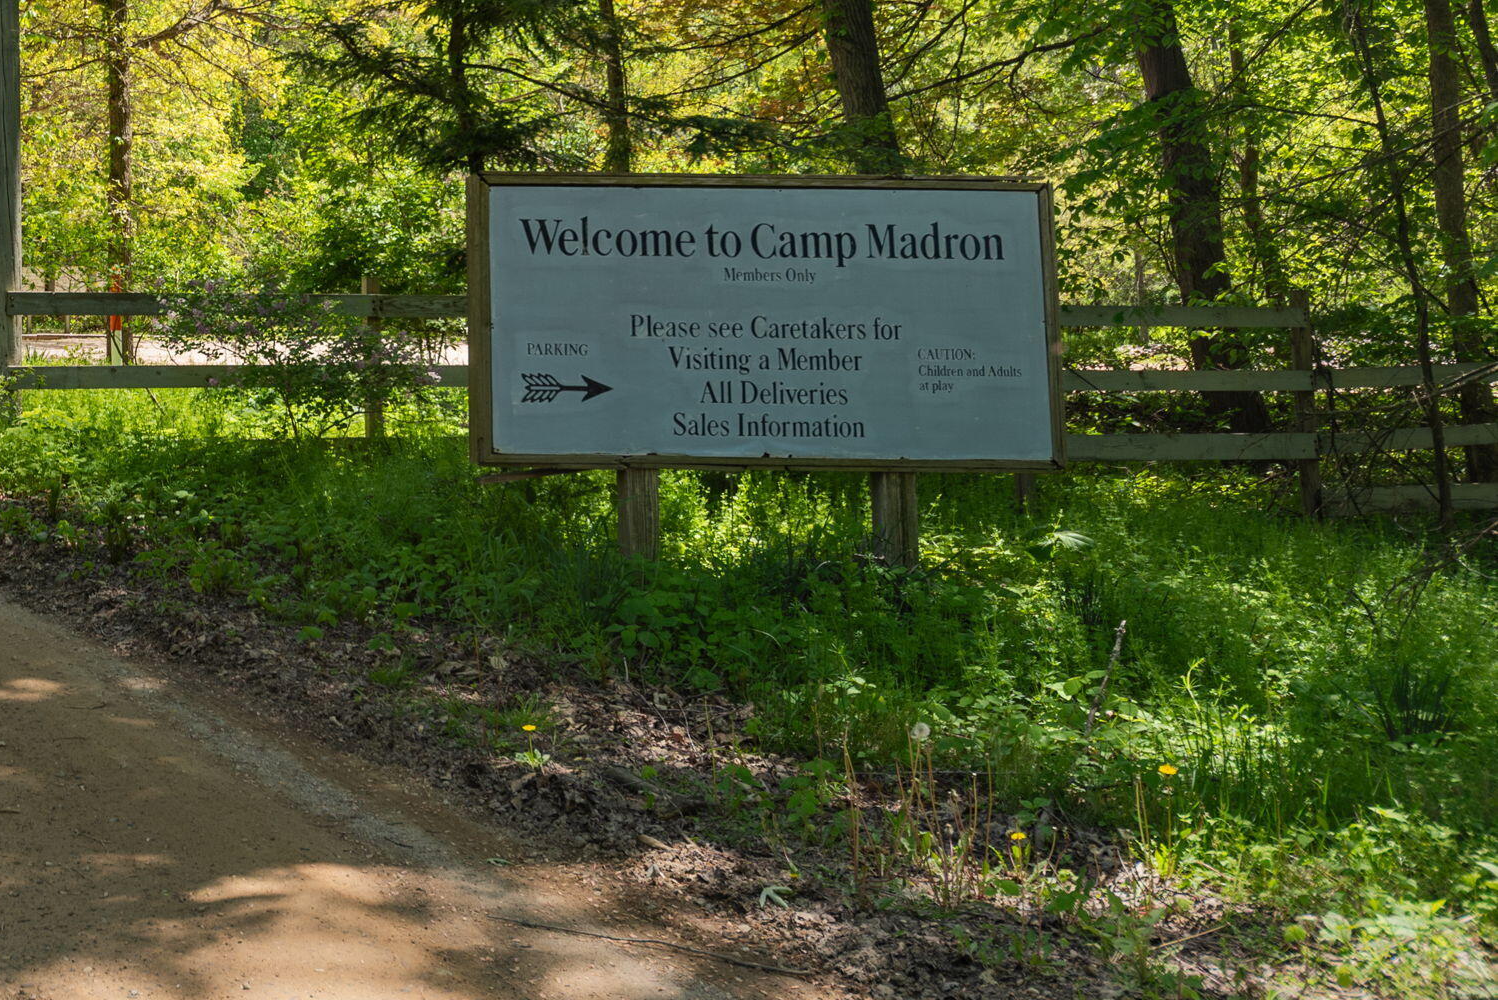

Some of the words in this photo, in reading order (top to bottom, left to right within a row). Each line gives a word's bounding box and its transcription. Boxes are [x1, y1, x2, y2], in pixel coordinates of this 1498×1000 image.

[519, 216, 696, 258] Welcome
[705, 223, 742, 258] to
[750, 222, 857, 267] Camp
[865, 221, 1005, 261] Madron
[723, 267, 782, 282] Members
[785, 267, 817, 285] Only
[629, 314, 701, 338] Please
[708, 322, 744, 339] see
[750, 315, 867, 340] Caretakers
[872, 316, 903, 341] for
[527, 342, 589, 357] PARKING
[668, 345, 751, 373] Visiting
[758, 354, 771, 371] a
[777, 347, 863, 372] Member
[918, 348, 975, 361] CAUTION:
[918, 364, 963, 377] Children
[966, 364, 985, 377] and
[988, 365, 1022, 377] Adults
[700, 380, 733, 404] All
[741, 380, 849, 406] Deliveries
[919, 381, 929, 391] at
[932, 380, 954, 394] play
[673, 411, 730, 437] Sales
[737, 412, 866, 439] Information
